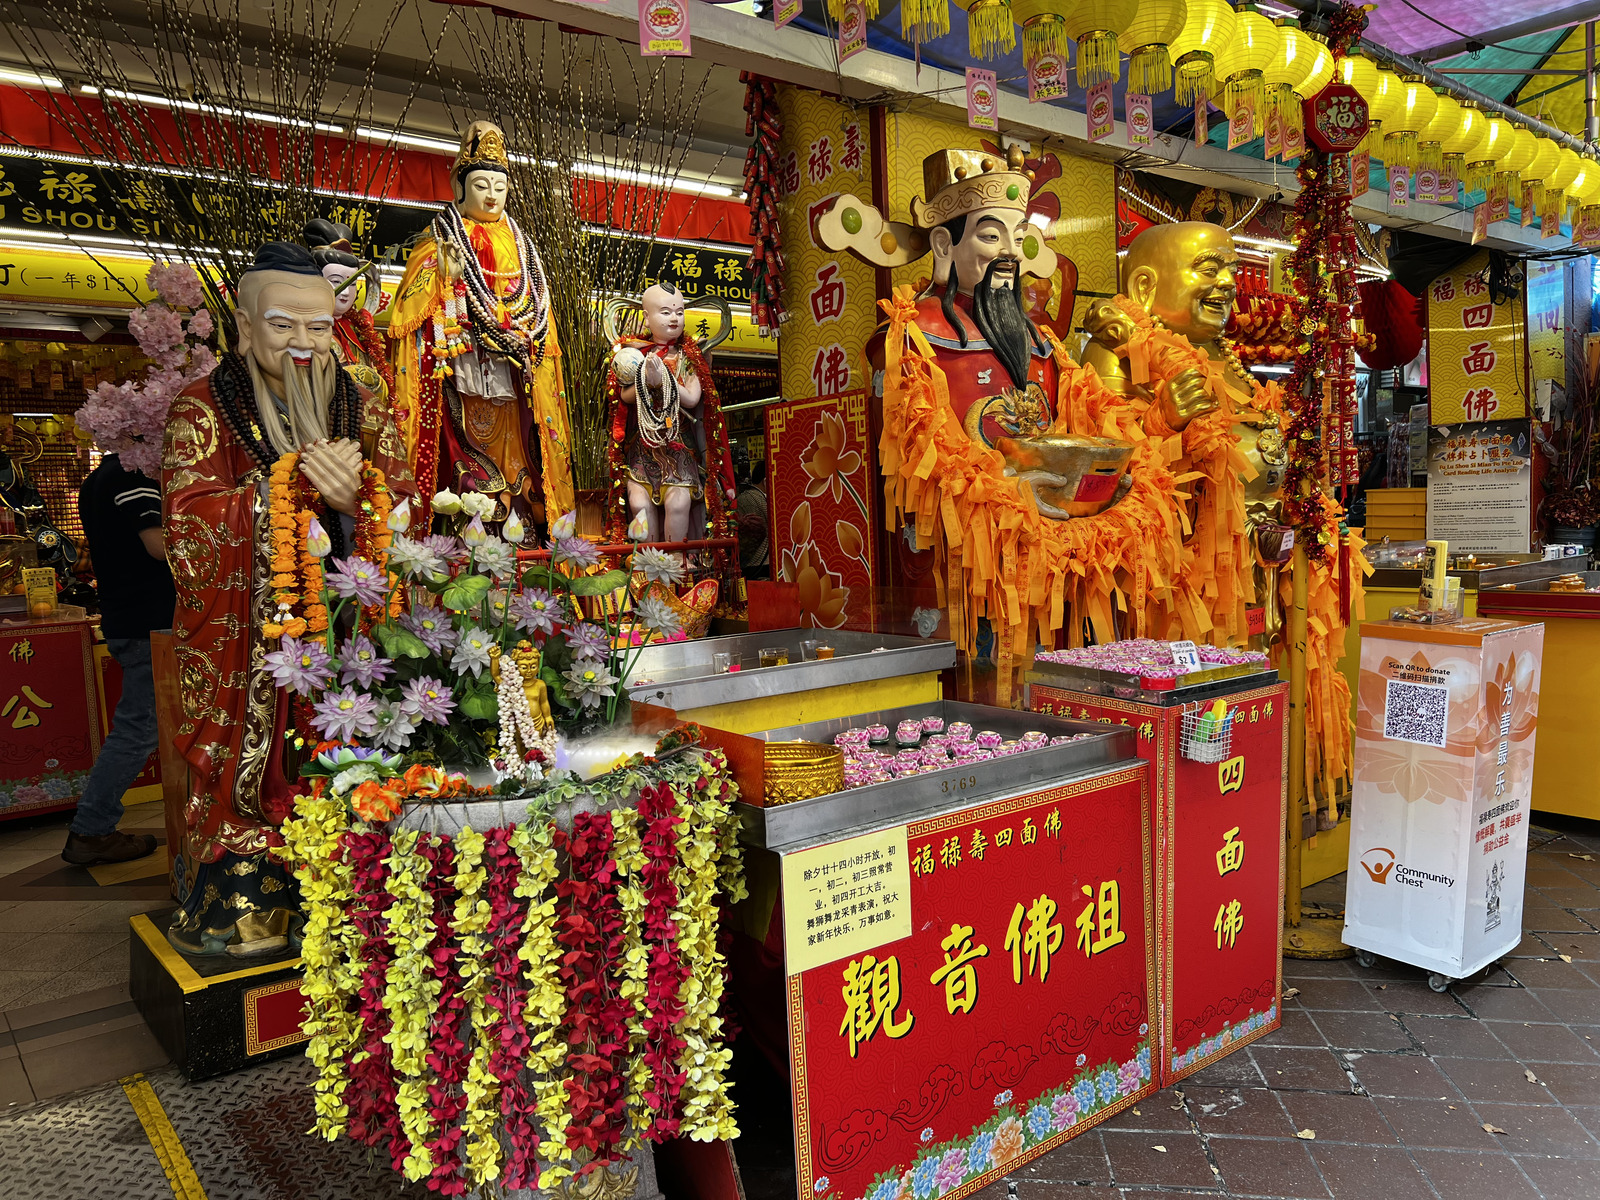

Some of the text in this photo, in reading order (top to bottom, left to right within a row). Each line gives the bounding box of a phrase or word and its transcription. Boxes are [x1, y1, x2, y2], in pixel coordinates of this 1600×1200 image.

[1327, 96, 1356, 129] 福
[22, 206, 116, 232] SHOU
[705, 284, 752, 300] SHOU
[1462, 303, 1497, 421] 四面佛
[8, 638, 35, 665] 佛
[1178, 655, 1188, 665] $2
[1388, 661, 1404, 670] Scan
[1425, 667, 1451, 676] donate
[1, 685, 54, 730] 公
[941, 775, 976, 793] 3769
[1213, 755, 1245, 951] 四面佛
[1395, 873, 1424, 889] Chest
[1396, 863, 1455, 888] Community
[838, 879, 1127, 1059] 觀音佛祖
